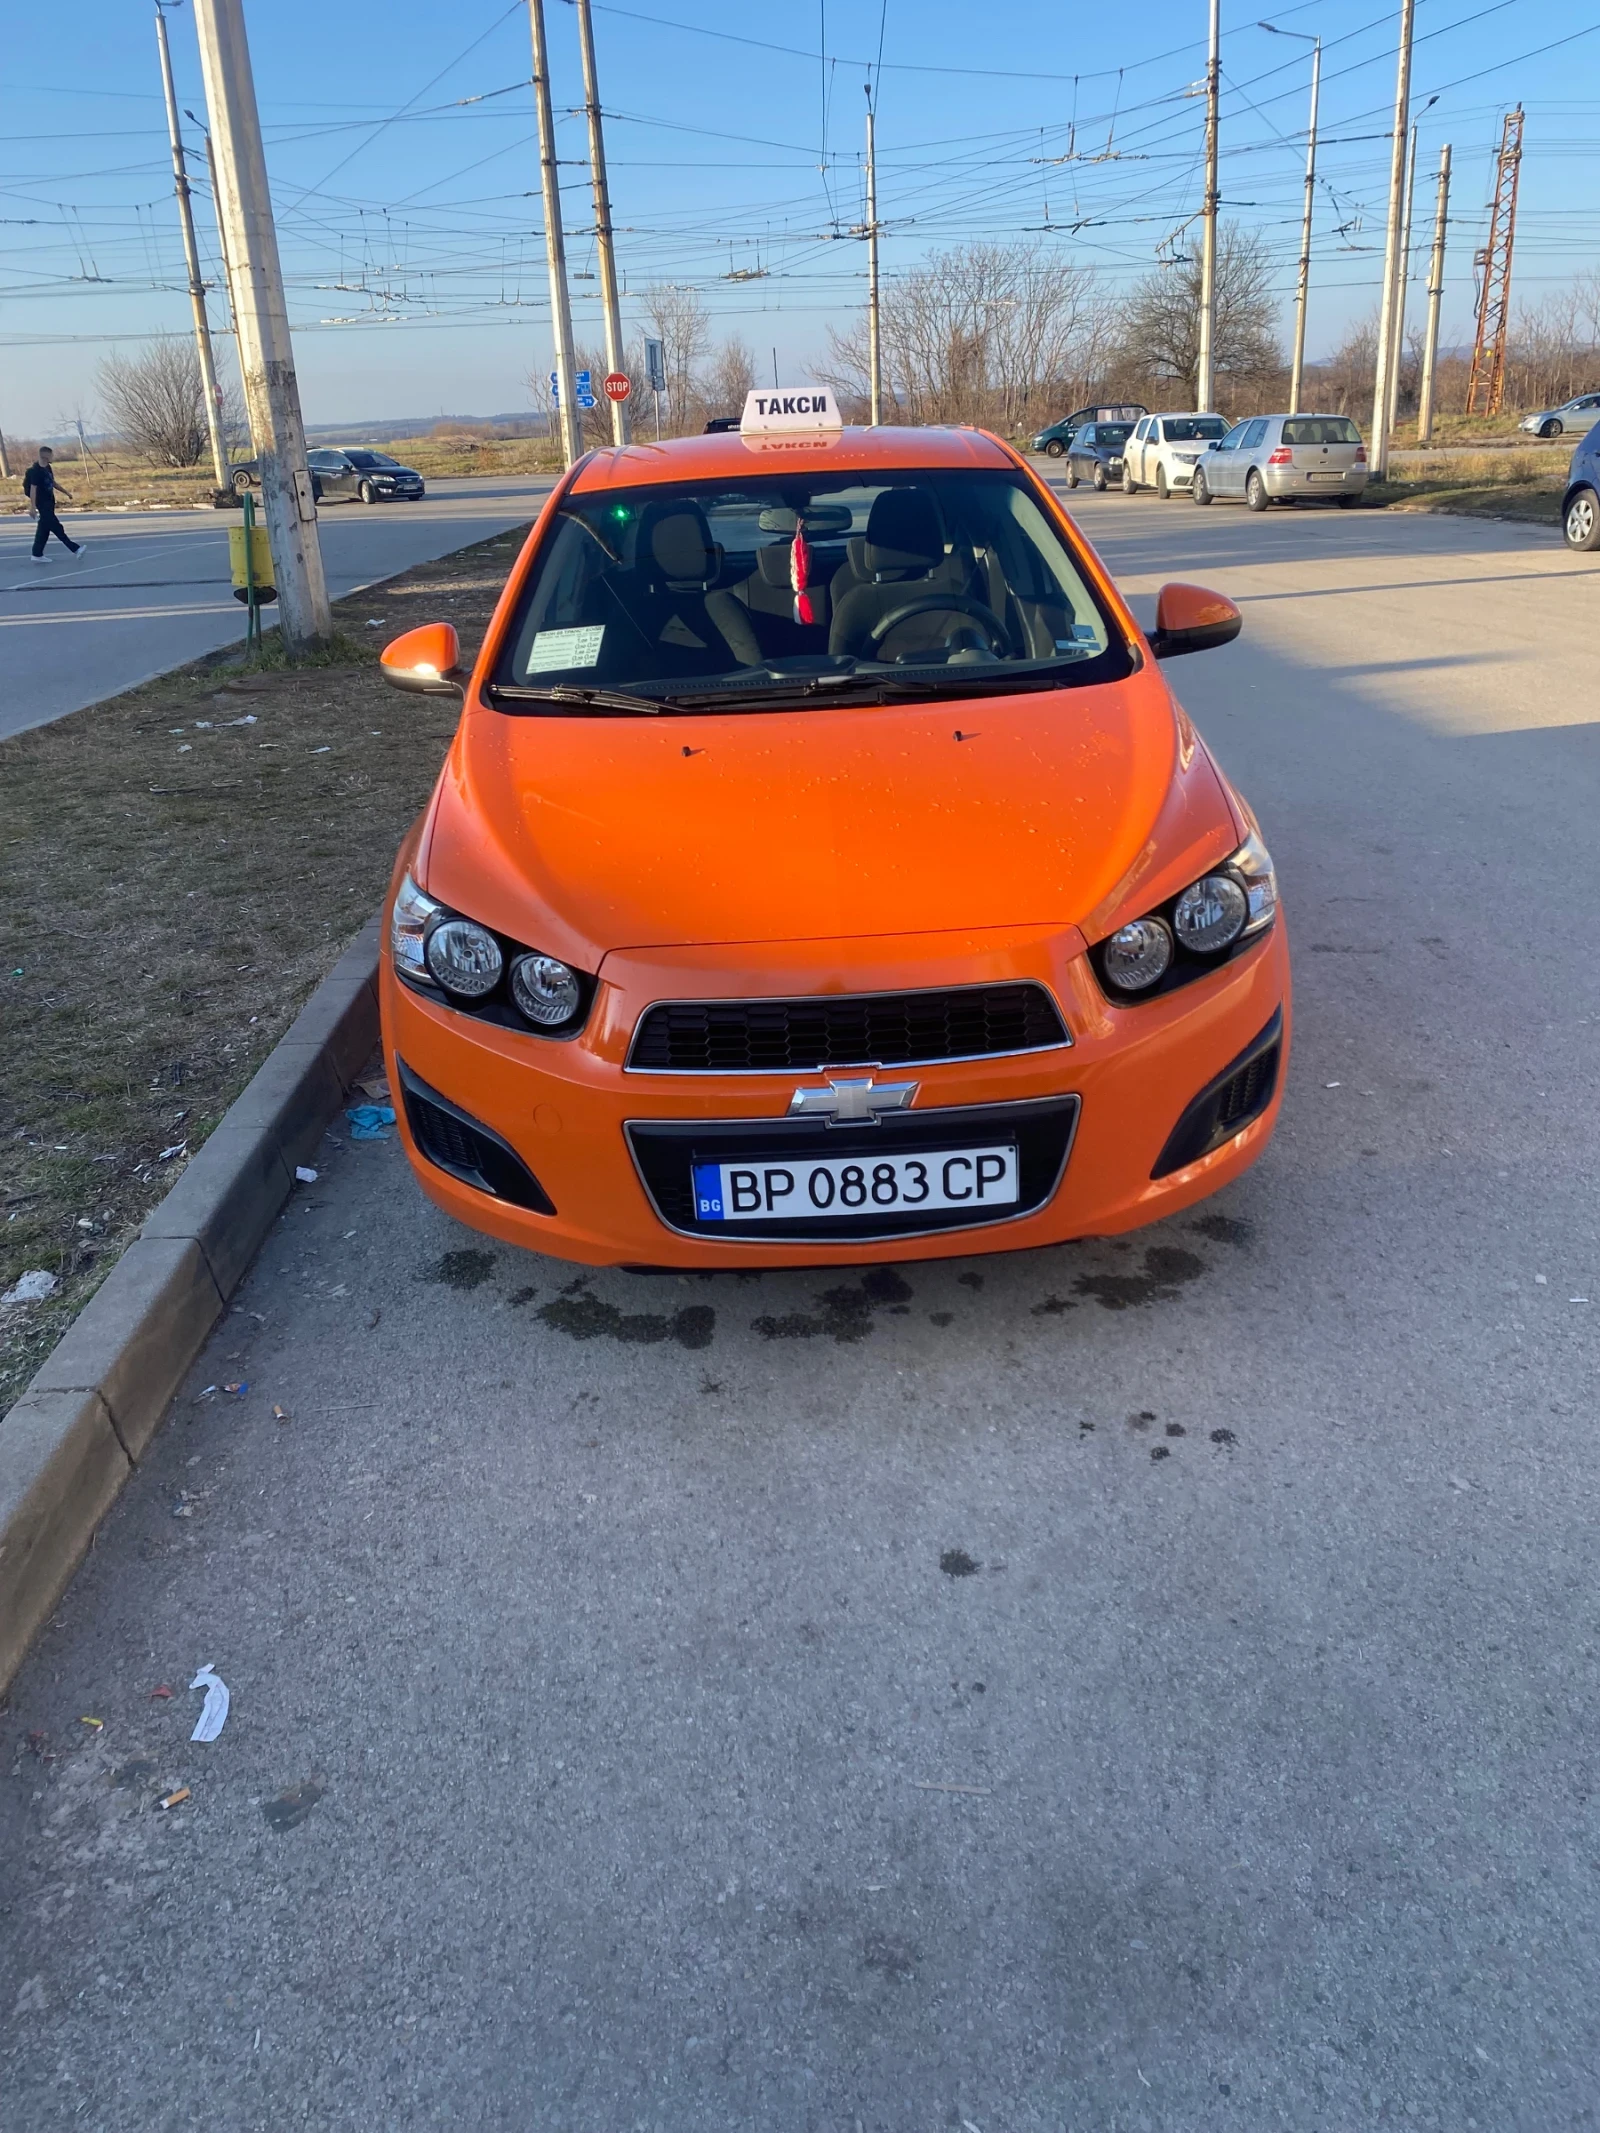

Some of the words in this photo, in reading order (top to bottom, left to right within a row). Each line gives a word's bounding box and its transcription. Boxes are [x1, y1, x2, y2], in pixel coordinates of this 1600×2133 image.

[606, 382, 629, 392] STOP
[755, 396, 827, 415] ТАКСИ
[729, 1169, 795, 1213] BP
[808, 1161, 930, 1209] 0883
[942, 1154, 1007, 1200] CP
[700, 1199, 721, 1213] BG
